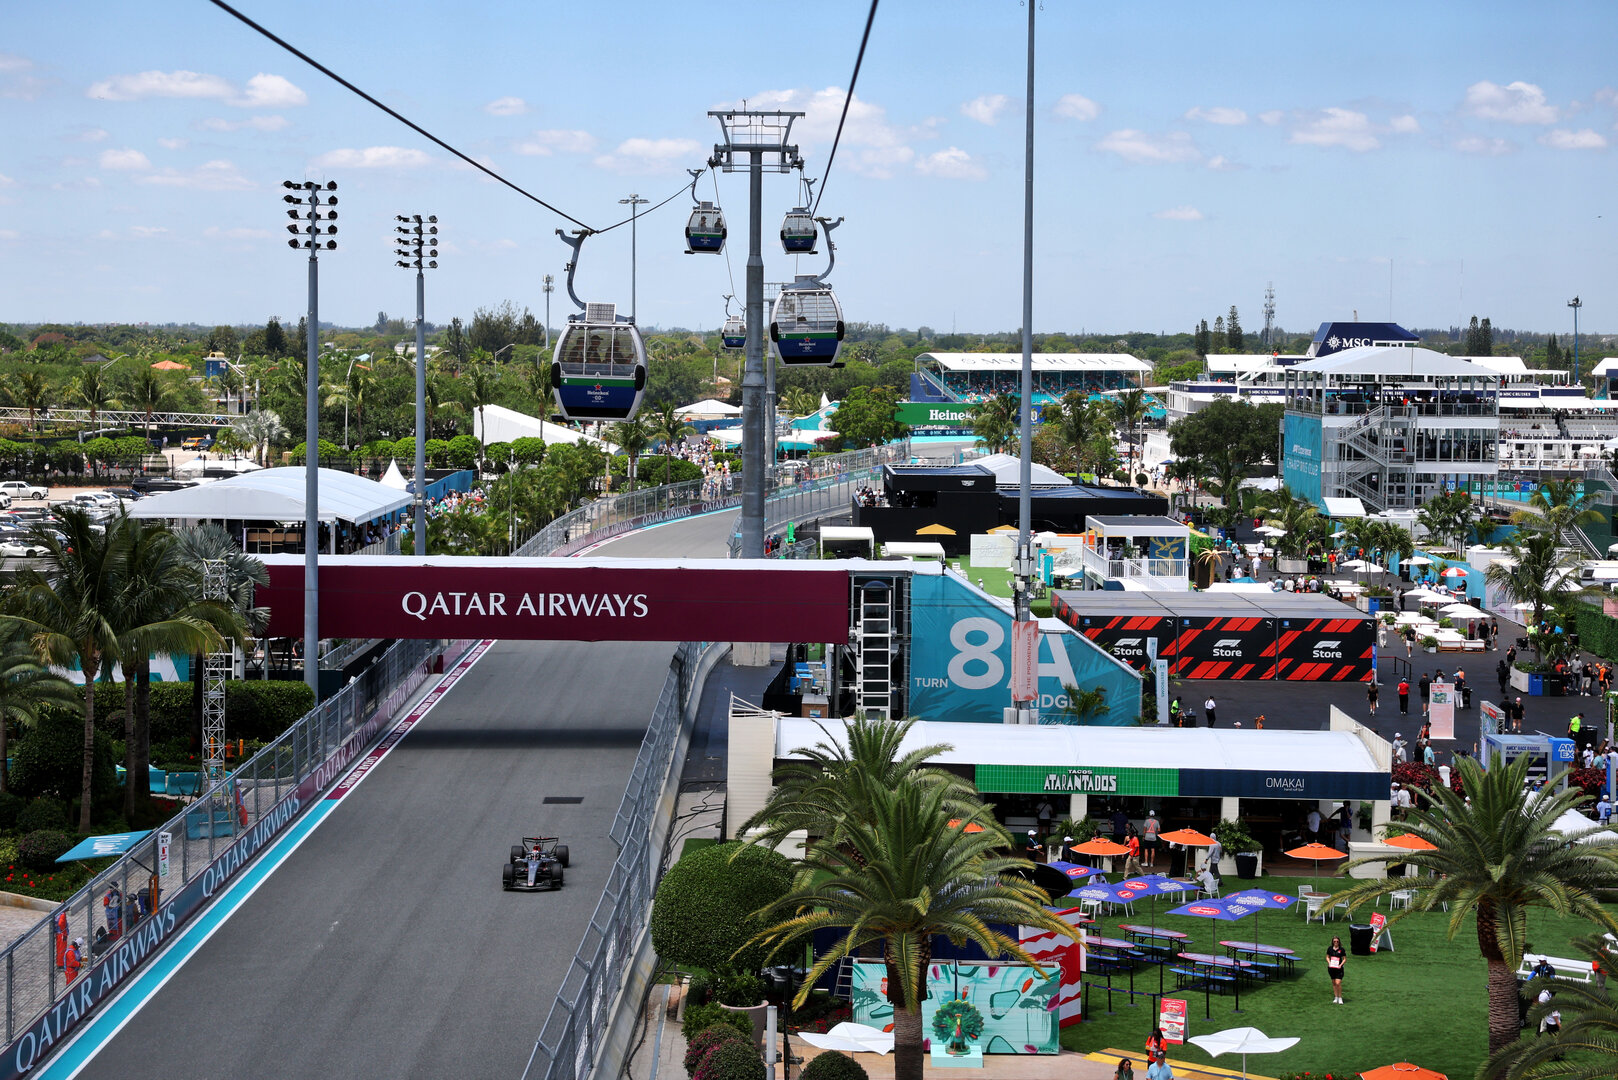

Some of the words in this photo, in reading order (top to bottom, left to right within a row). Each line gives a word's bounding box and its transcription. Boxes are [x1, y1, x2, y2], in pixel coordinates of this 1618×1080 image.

[1342, 338, 1372, 348] MSC
[929, 410, 976, 420] Heinek
[702, 500, 724, 512] QATAR
[725, 496, 742, 507] AIRW
[642, 512, 663, 526] QATAR
[664, 506, 691, 520] AIRWAYS
[402, 591, 507, 620] QATAR
[516, 592, 648, 618] AIRWAYS
[1114, 638, 1142, 646] F1
[1214, 639, 1242, 648] F1
[1313, 640, 1342, 648] F1
[1114, 647, 1142, 656] Store
[1212, 648, 1242, 656] Store
[1312, 650, 1342, 658] Store
[914, 677, 948, 688] TURN
[1558, 744, 1574, 752] AM
[316, 748, 348, 792] QATAR
[348, 722, 378, 762] AIRWAYS
[1044, 774, 1116, 792] ATARANTADOS
[1266, 778, 1304, 788] OMAKAI
[202, 836, 248, 897] QATAR
[252, 790, 300, 854] AIRWAYS
[16, 977, 94, 1074] QATAR
[98, 902, 176, 998] AIRWAYS
